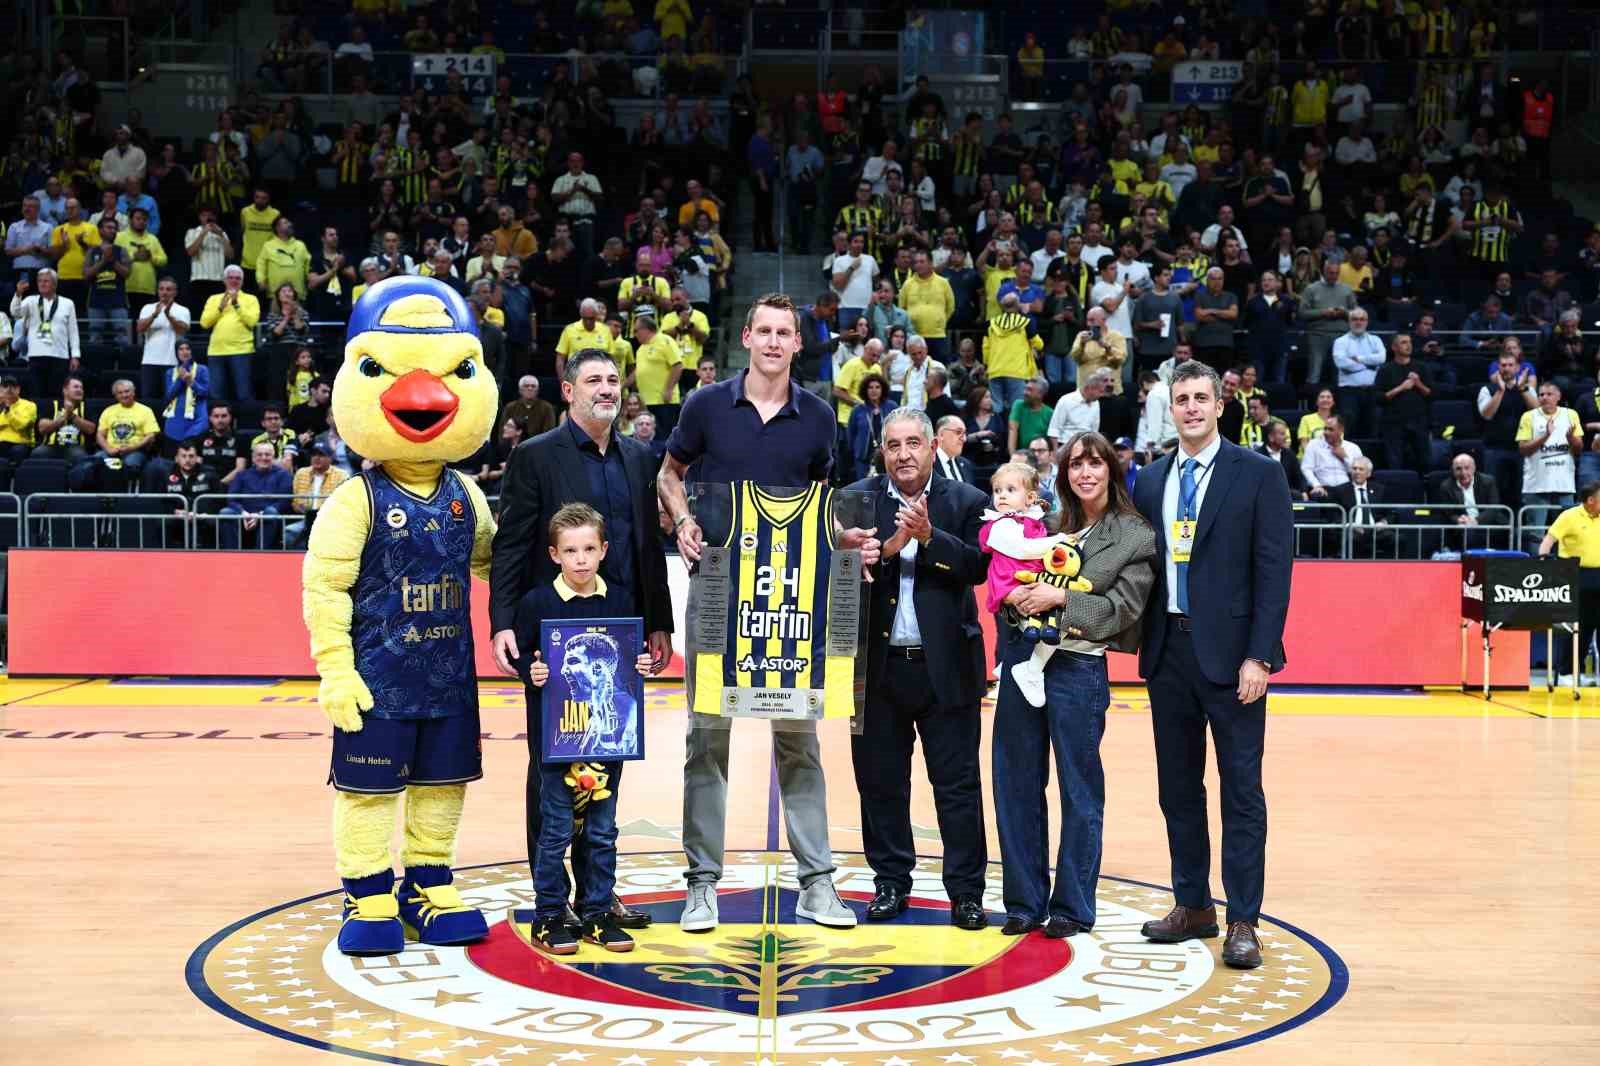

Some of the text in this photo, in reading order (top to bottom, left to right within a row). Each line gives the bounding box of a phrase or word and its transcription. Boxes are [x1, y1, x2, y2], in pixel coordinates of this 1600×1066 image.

[446, 57, 485, 72] 214
[1210, 66, 1239, 79] 213
[756, 565, 799, 597] 24
[401, 575, 463, 613] tarfin
[1494, 584, 1572, 603] SPALDING
[741, 602, 809, 639] tarfin
[760, 659, 803, 671] ASTOR
[768, 692, 792, 700] VESELY
[560, 699, 589, 733] JAN
